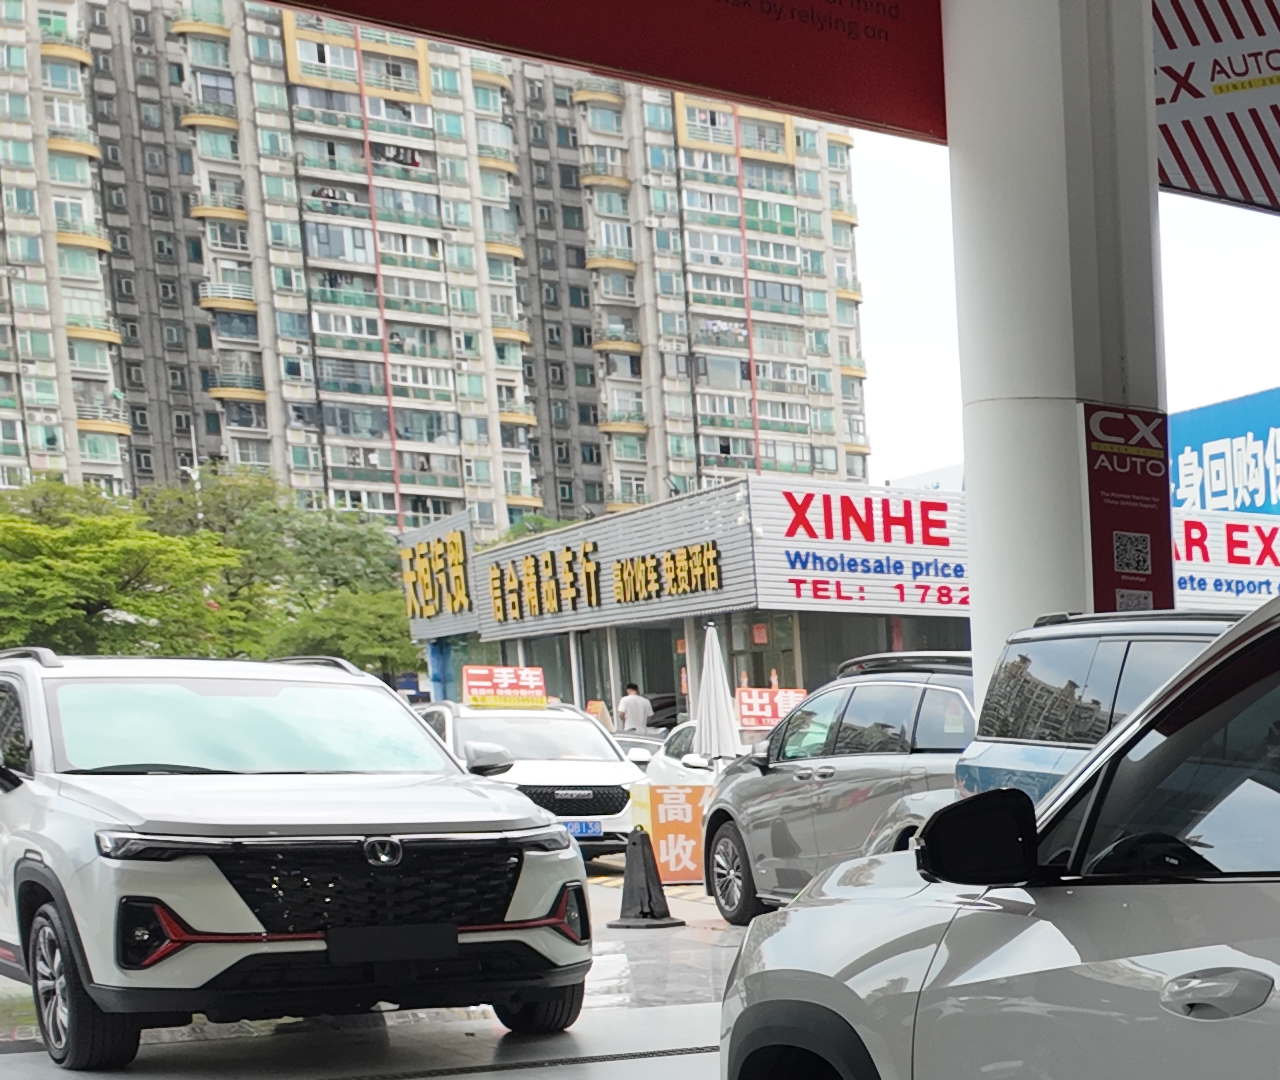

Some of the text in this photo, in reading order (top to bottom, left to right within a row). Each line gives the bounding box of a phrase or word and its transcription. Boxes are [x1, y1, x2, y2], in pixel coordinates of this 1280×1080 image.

[758, 0, 785, 21] by
[790, 5, 860, 40] relying
[863, 24, 889, 42] on
[1089, 410, 1164, 449] CX
[1093, 453, 1166, 478] AUTO
[782, 490, 950, 547] XINHE
[784, 550, 965, 580] Wholesale price
[489, 540, 721, 622] 信合精品车行 高价收车 免费评估
[788, 578, 866, 601] TEL:
[1177, 574, 1208, 592] ete
[1213, 574, 1272, 598] export
[467, 668, 543, 689] 二手车
[741, 690, 804, 718] 出售
[659, 834, 697, 871] 收
